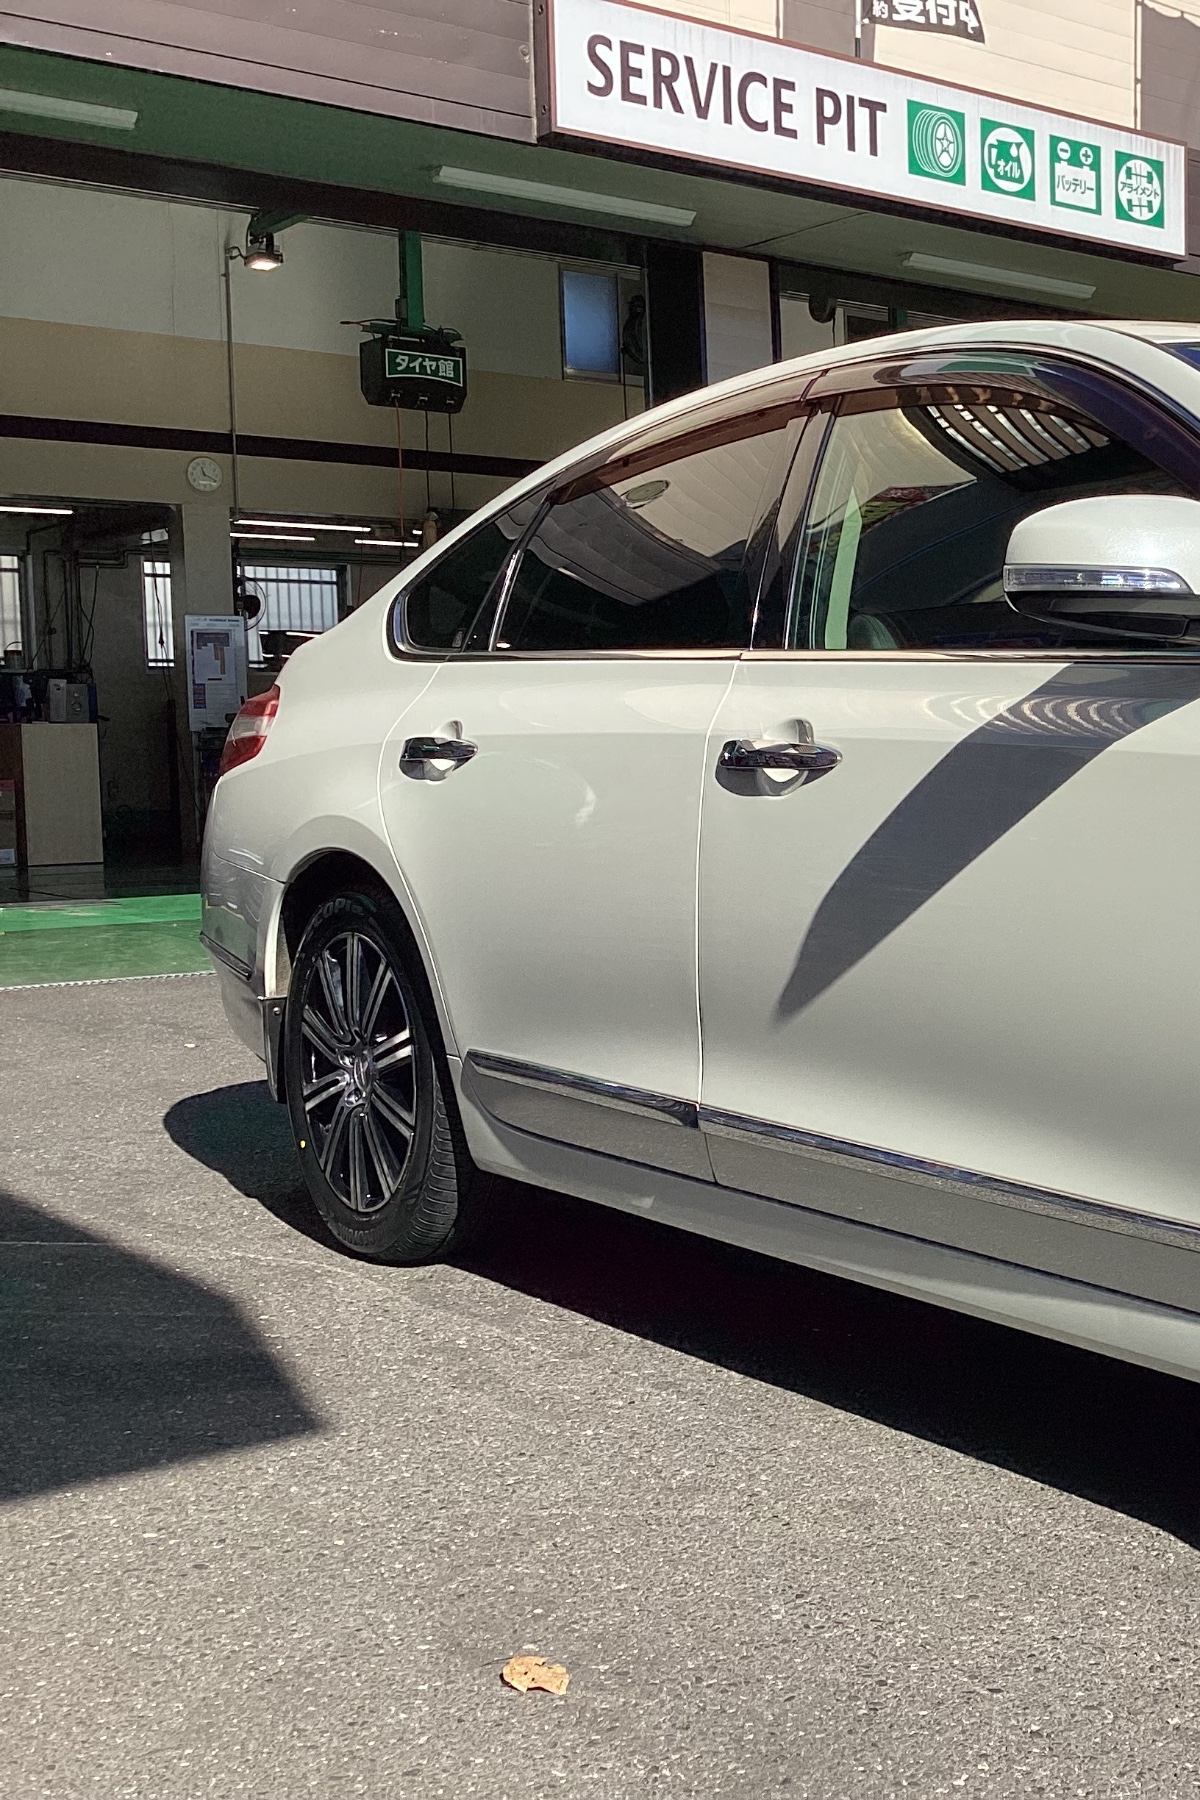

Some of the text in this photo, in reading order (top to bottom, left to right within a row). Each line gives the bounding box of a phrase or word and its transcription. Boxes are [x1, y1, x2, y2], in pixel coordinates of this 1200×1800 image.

[586, 34, 888, 157] SERVICE PIT
[997, 157, 1021, 179] オイル
[1056, 174, 1095, 195] バッテリー
[1119, 181, 1160, 200] アライメント
[395, 354, 454, 378] タイヤ館
